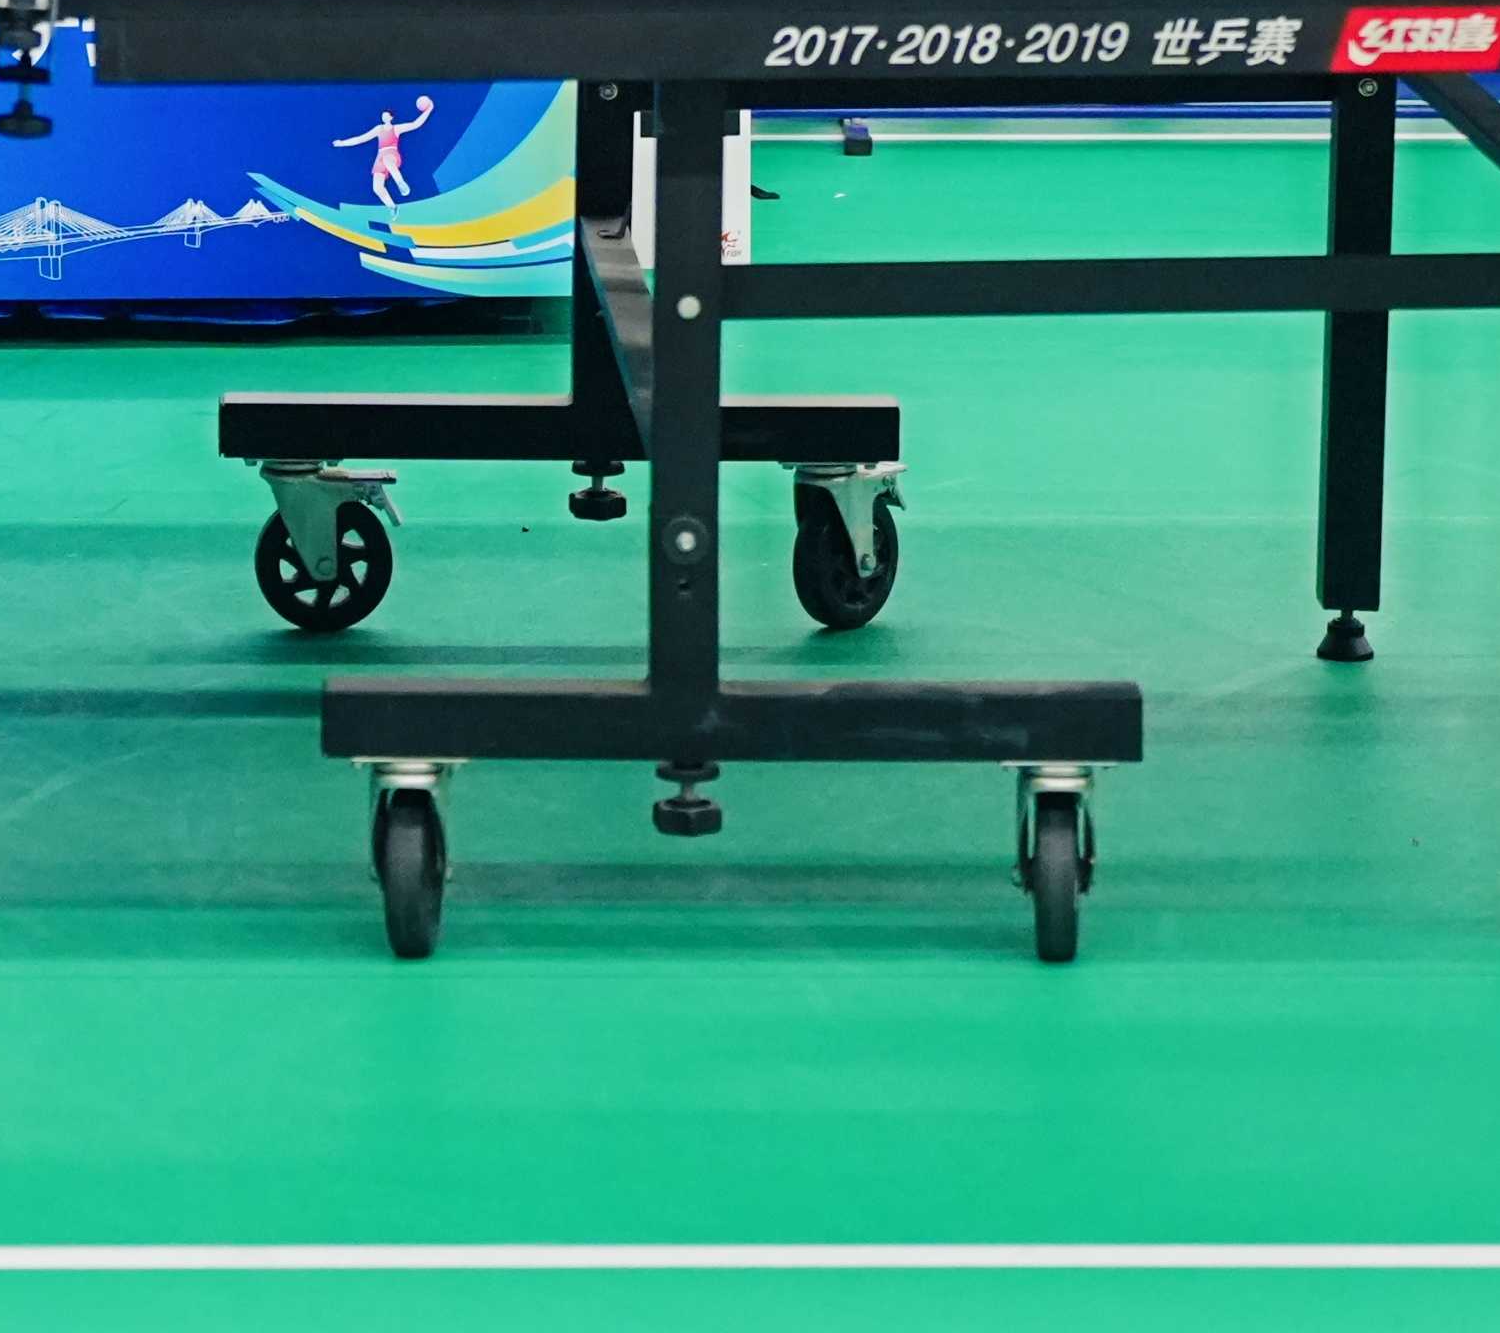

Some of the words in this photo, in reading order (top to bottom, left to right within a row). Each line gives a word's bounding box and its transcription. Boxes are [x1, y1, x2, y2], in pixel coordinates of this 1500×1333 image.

[1150, 15, 1304, 68] 世乒赛
[1348, 12, 1499, 67] 红双喜
